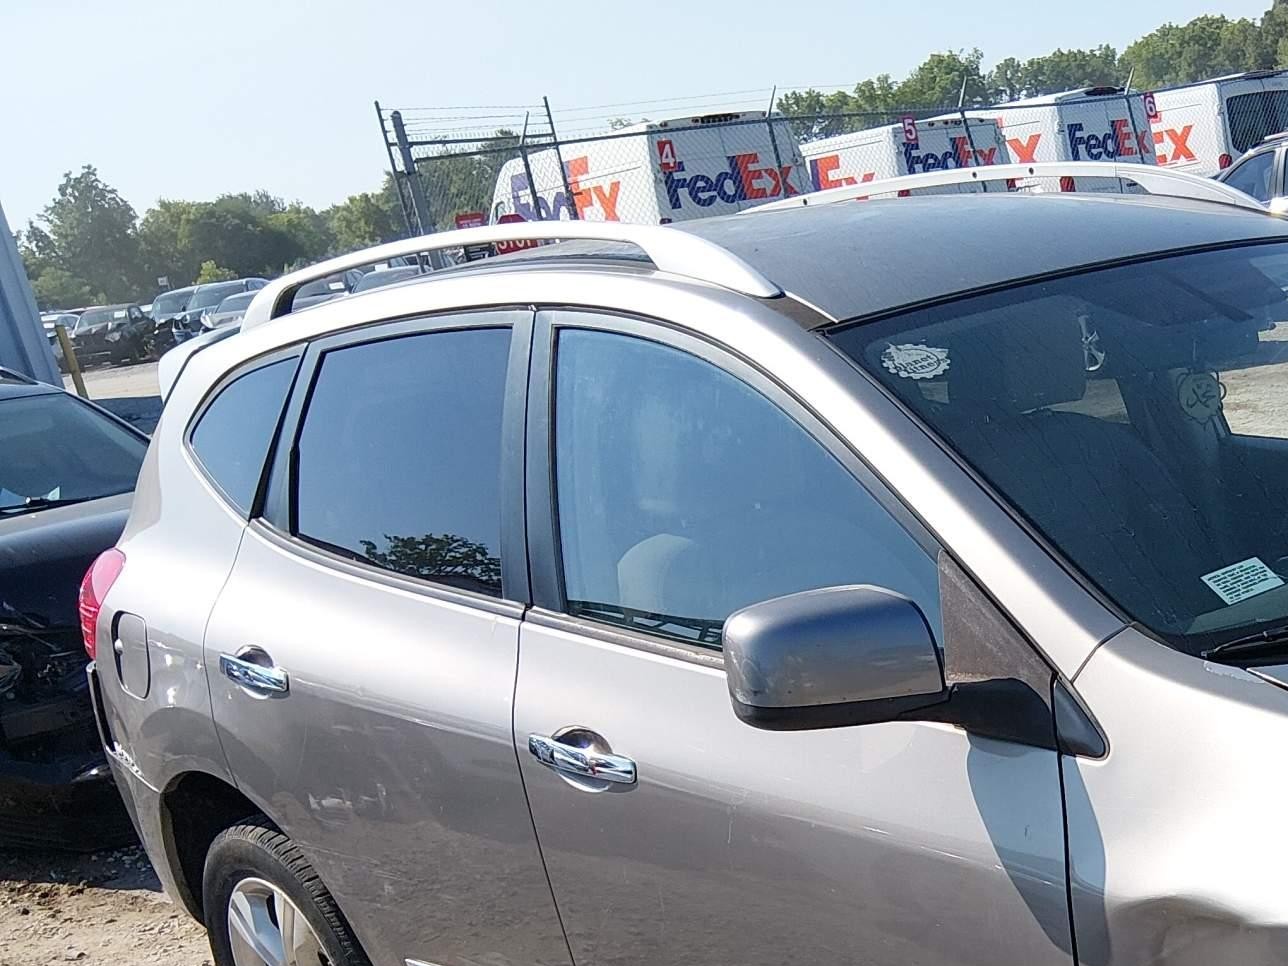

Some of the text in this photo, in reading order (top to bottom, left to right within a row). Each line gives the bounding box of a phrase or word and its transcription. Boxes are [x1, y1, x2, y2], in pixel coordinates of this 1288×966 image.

[1145, 96, 1156, 116] 6
[904, 119, 916, 140] 5
[1067, 119, 1151, 161] FedEx
[662, 144, 675, 167] 4
[664, 153, 800, 209] FedEx
